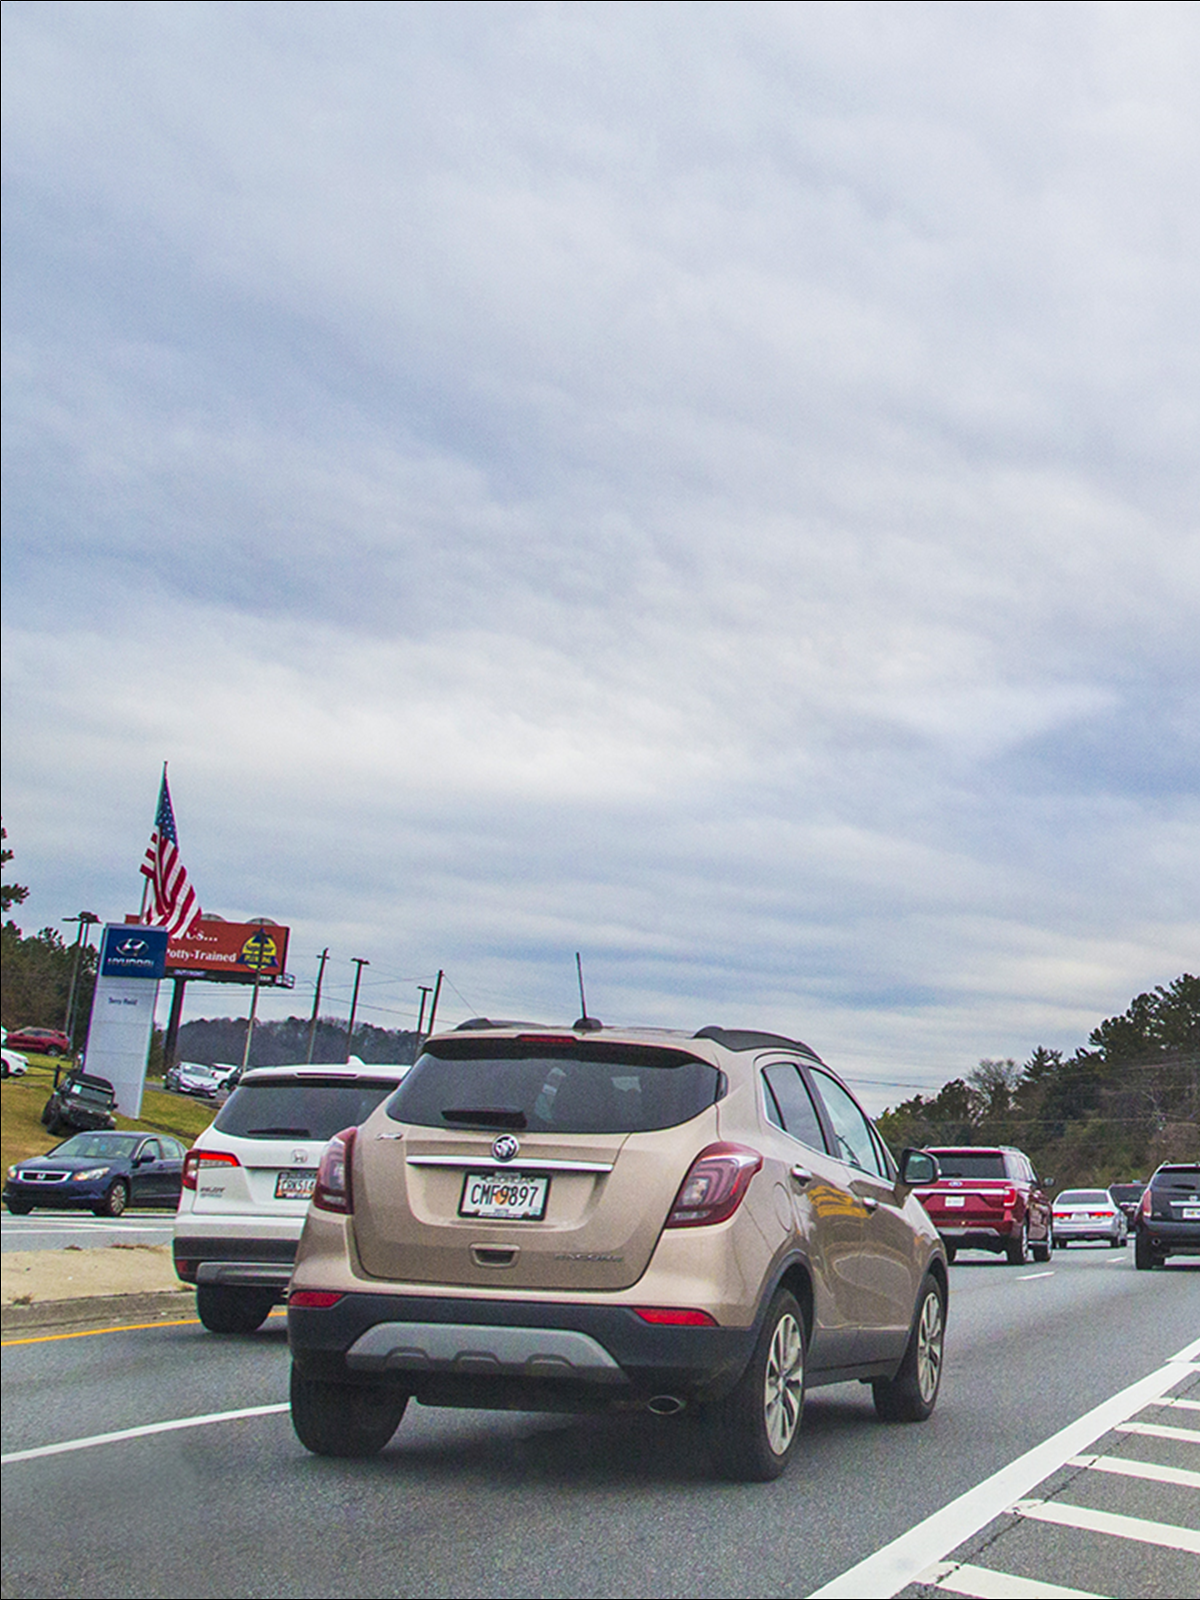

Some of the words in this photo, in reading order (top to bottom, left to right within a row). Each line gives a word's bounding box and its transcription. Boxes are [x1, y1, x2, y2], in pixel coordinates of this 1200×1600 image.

[167, 948, 237, 962] otty-Trained
[108, 957, 155, 968] HYUNDAI
[470, 1184, 539, 1207] CMF9897
